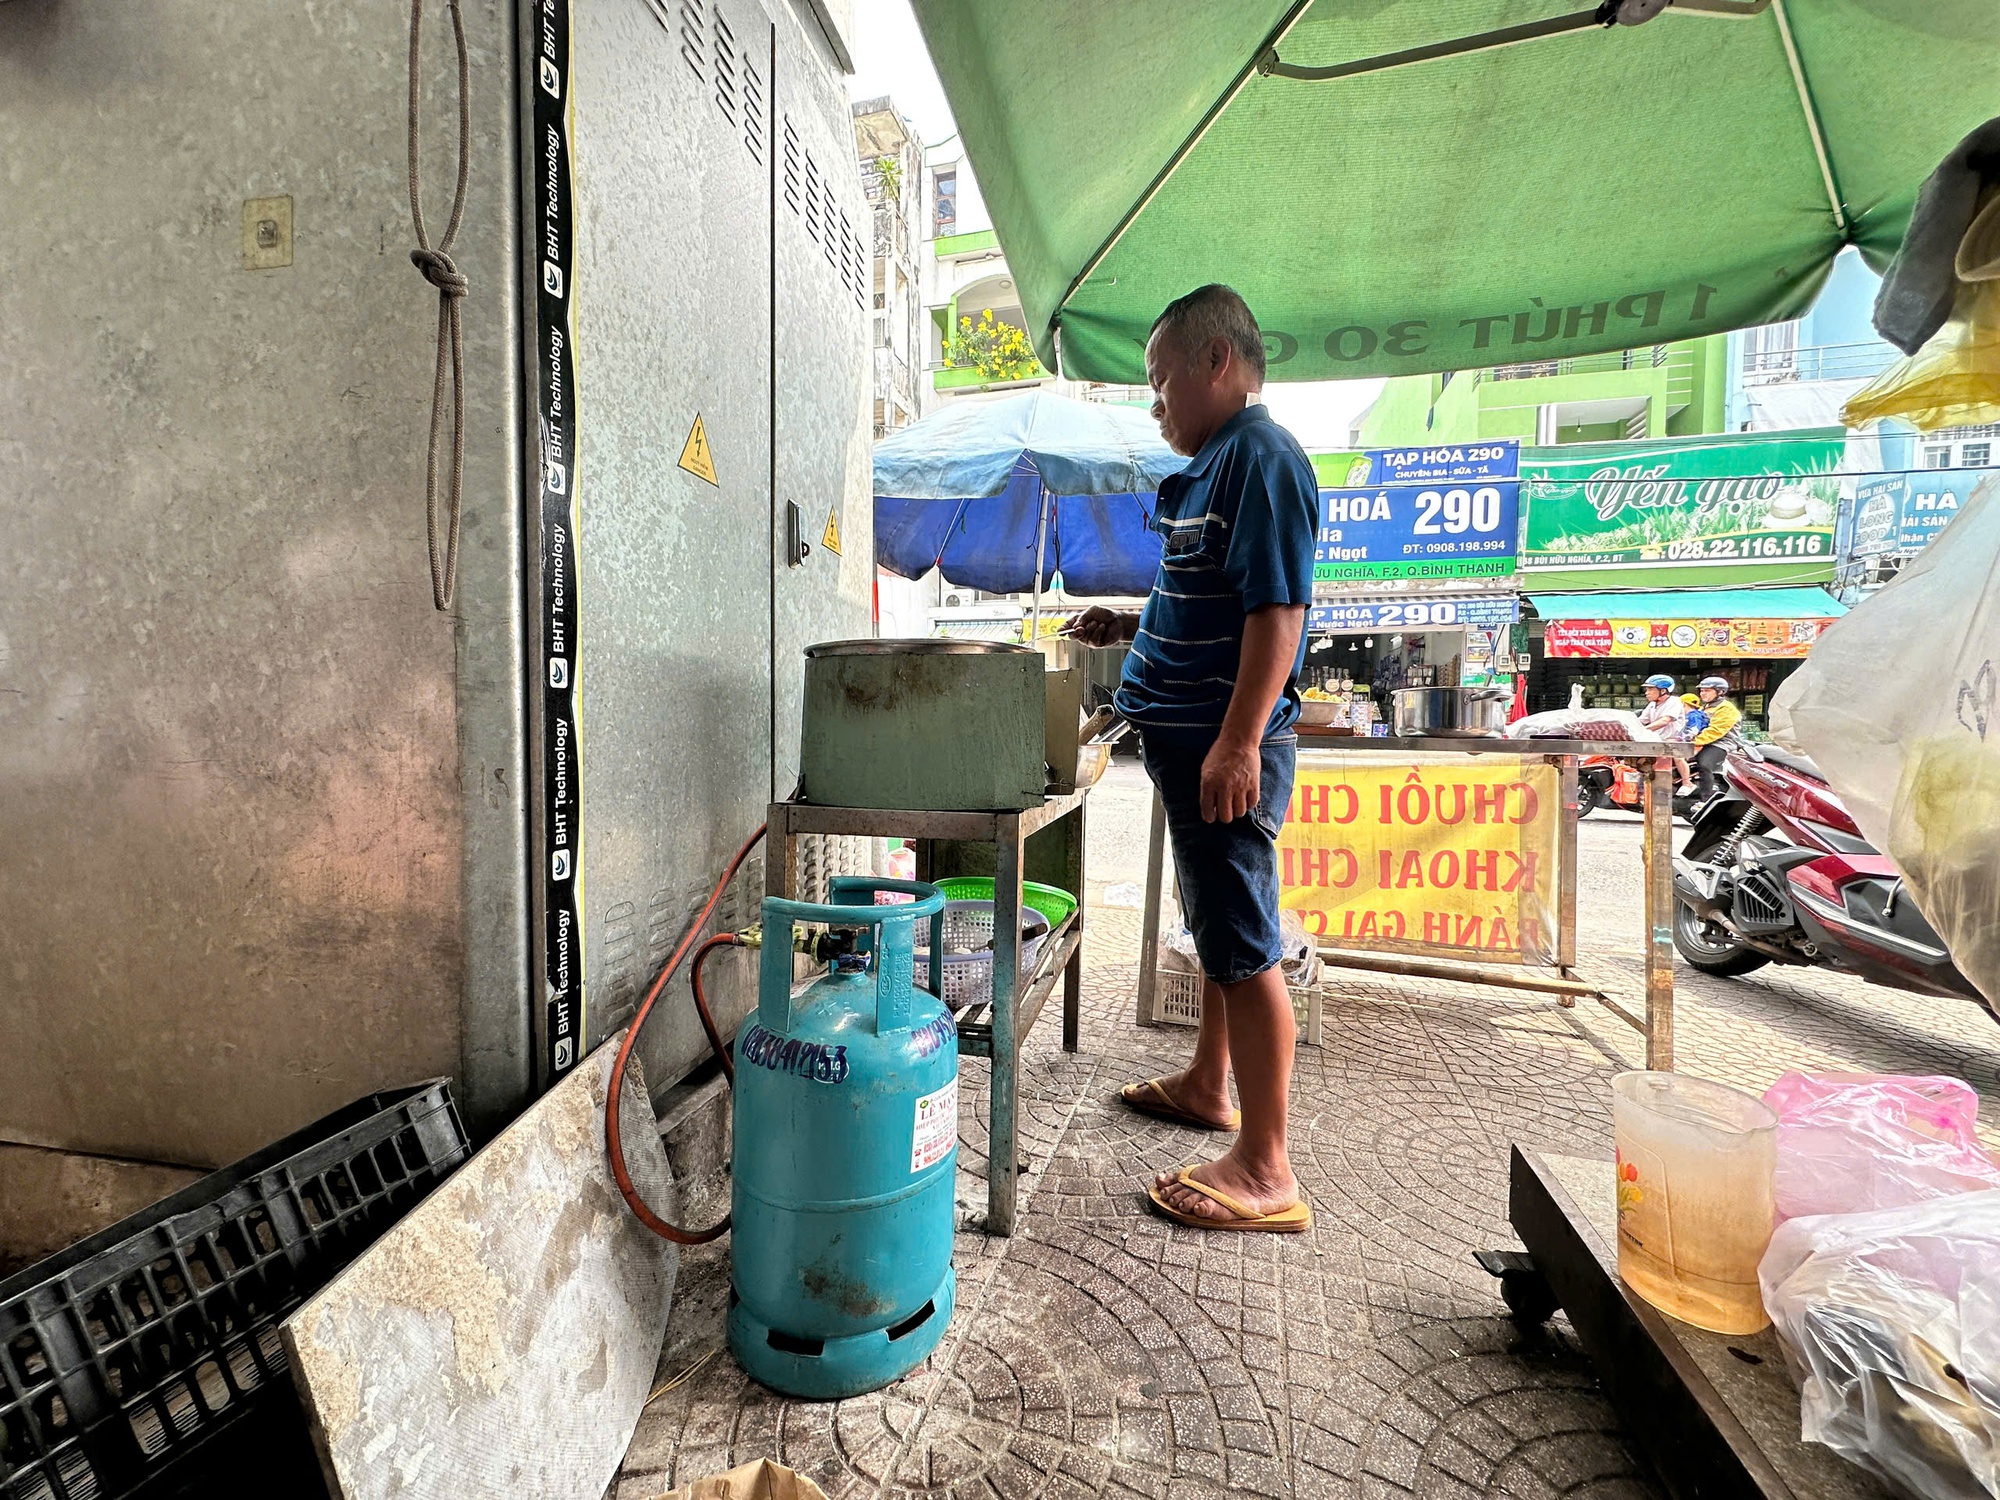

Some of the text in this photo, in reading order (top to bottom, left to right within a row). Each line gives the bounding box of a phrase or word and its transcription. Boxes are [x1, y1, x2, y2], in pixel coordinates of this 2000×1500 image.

[544, 17, 555, 59] BHT
[546, 124, 559, 260] BHT Technology
[549, 325, 563, 461] BHT Technology
[1383, 447, 1504, 470] TẠP HÓA 290
[1585, 464, 1784, 521] Yến gạo
[1915, 489, 1959, 511] HÀ
[1328, 487, 1501, 536] HOÁ 290
[1859, 511, 1894, 529] LONG
[1922, 513, 1948, 526] SẢN
[1403, 540, 1506, 554] ĐT: 0908.198.994
[1668, 535, 1822, 560] 028.22.116.116
[1854, 528, 1887, 544] FOOD
[1329, 546, 1367, 561] Ngọt
[1534, 555, 1548, 565] BÙI
[1612, 553, 1624, 562] BT
[1314, 563, 1505, 579] ỮU NGHĨA, F.2, Q.BÌNH THẠNH
[551, 523, 565, 652] BHT Technology
[1332, 606, 1373, 620] HÓA
[1377, 603, 1456, 626] 290
[555, 718, 567, 844] BHT Technology
[557, 909, 570, 1034] BHT Technology
